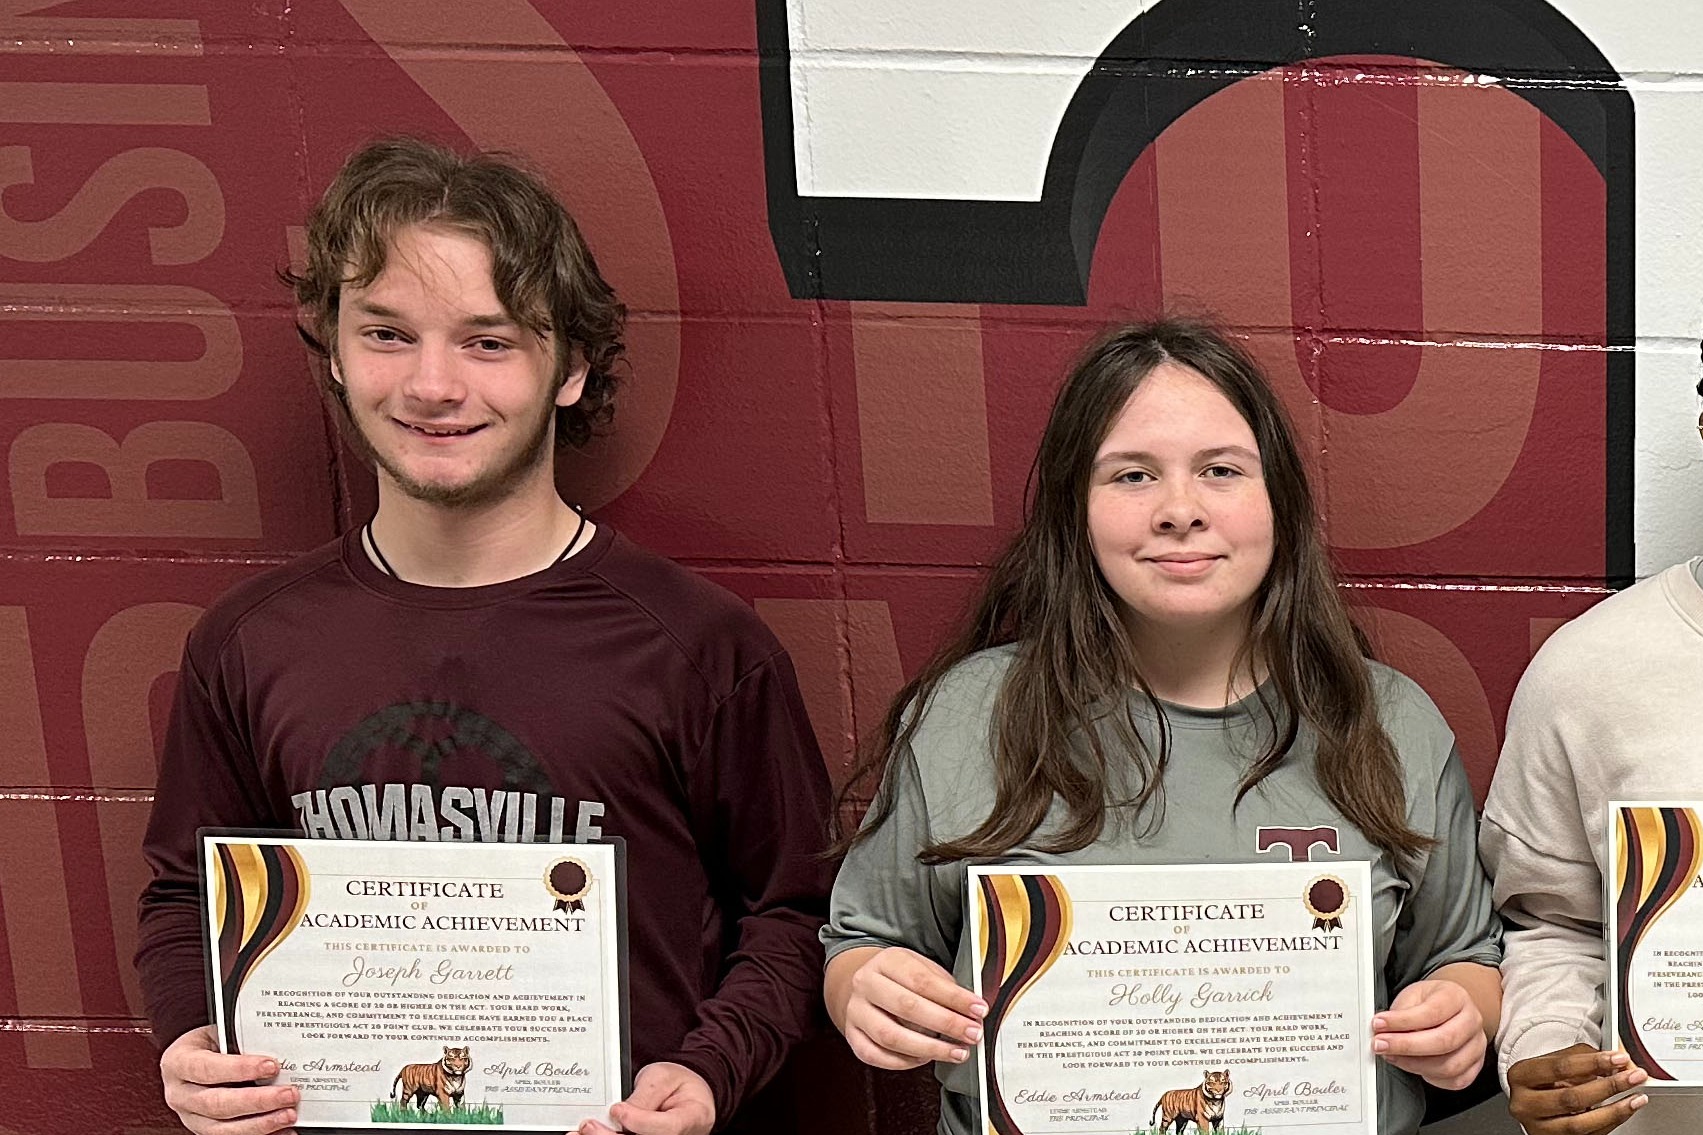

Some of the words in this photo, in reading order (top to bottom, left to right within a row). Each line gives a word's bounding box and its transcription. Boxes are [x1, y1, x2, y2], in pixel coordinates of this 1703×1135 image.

[290, 783, 605, 844] THOMASVILLE
[345, 880, 503, 898] CERTIFICATE
[409, 901, 428, 910] OF
[1109, 903, 1264, 921] CERTIFICATE
[300, 913, 416, 929] ACADEMIC
[421, 915, 585, 931] ACHIEVEMENT
[1172, 924, 1190, 934] OF
[323, 941, 352, 951] THIS
[354, 942, 432, 952] CERTIFICATE
[435, 944, 447, 952] IS
[450, 944, 511, 953] AWARDED
[513, 945, 530, 954] TO
[1063, 939, 1178, 955] ACADEMIC
[1184, 935, 1341, 953] ACHIEVEMENT
[341, 955, 421, 987] Joseph
[429, 958, 513, 984] Garrett
[1086, 969, 1115, 978] THIS
[1117, 967, 1195, 977] CERTIFICATE
[1197, 967, 1209, 975] IS
[1211, 965, 1271, 975] AWARDED
[1273, 965, 1291, 974] TO
[1108, 982, 1182, 1015] Holly
[1189, 980, 1273, 1008] Garrick
[1641, 1016, 1682, 1032] Eddie
[302, 1058, 381, 1072] Armstead
[482, 1061, 531, 1080] April
[1013, 1088, 1057, 1104] Eddie
[1062, 1087, 1141, 1102] Armstead
[1242, 1081, 1290, 1102] April
